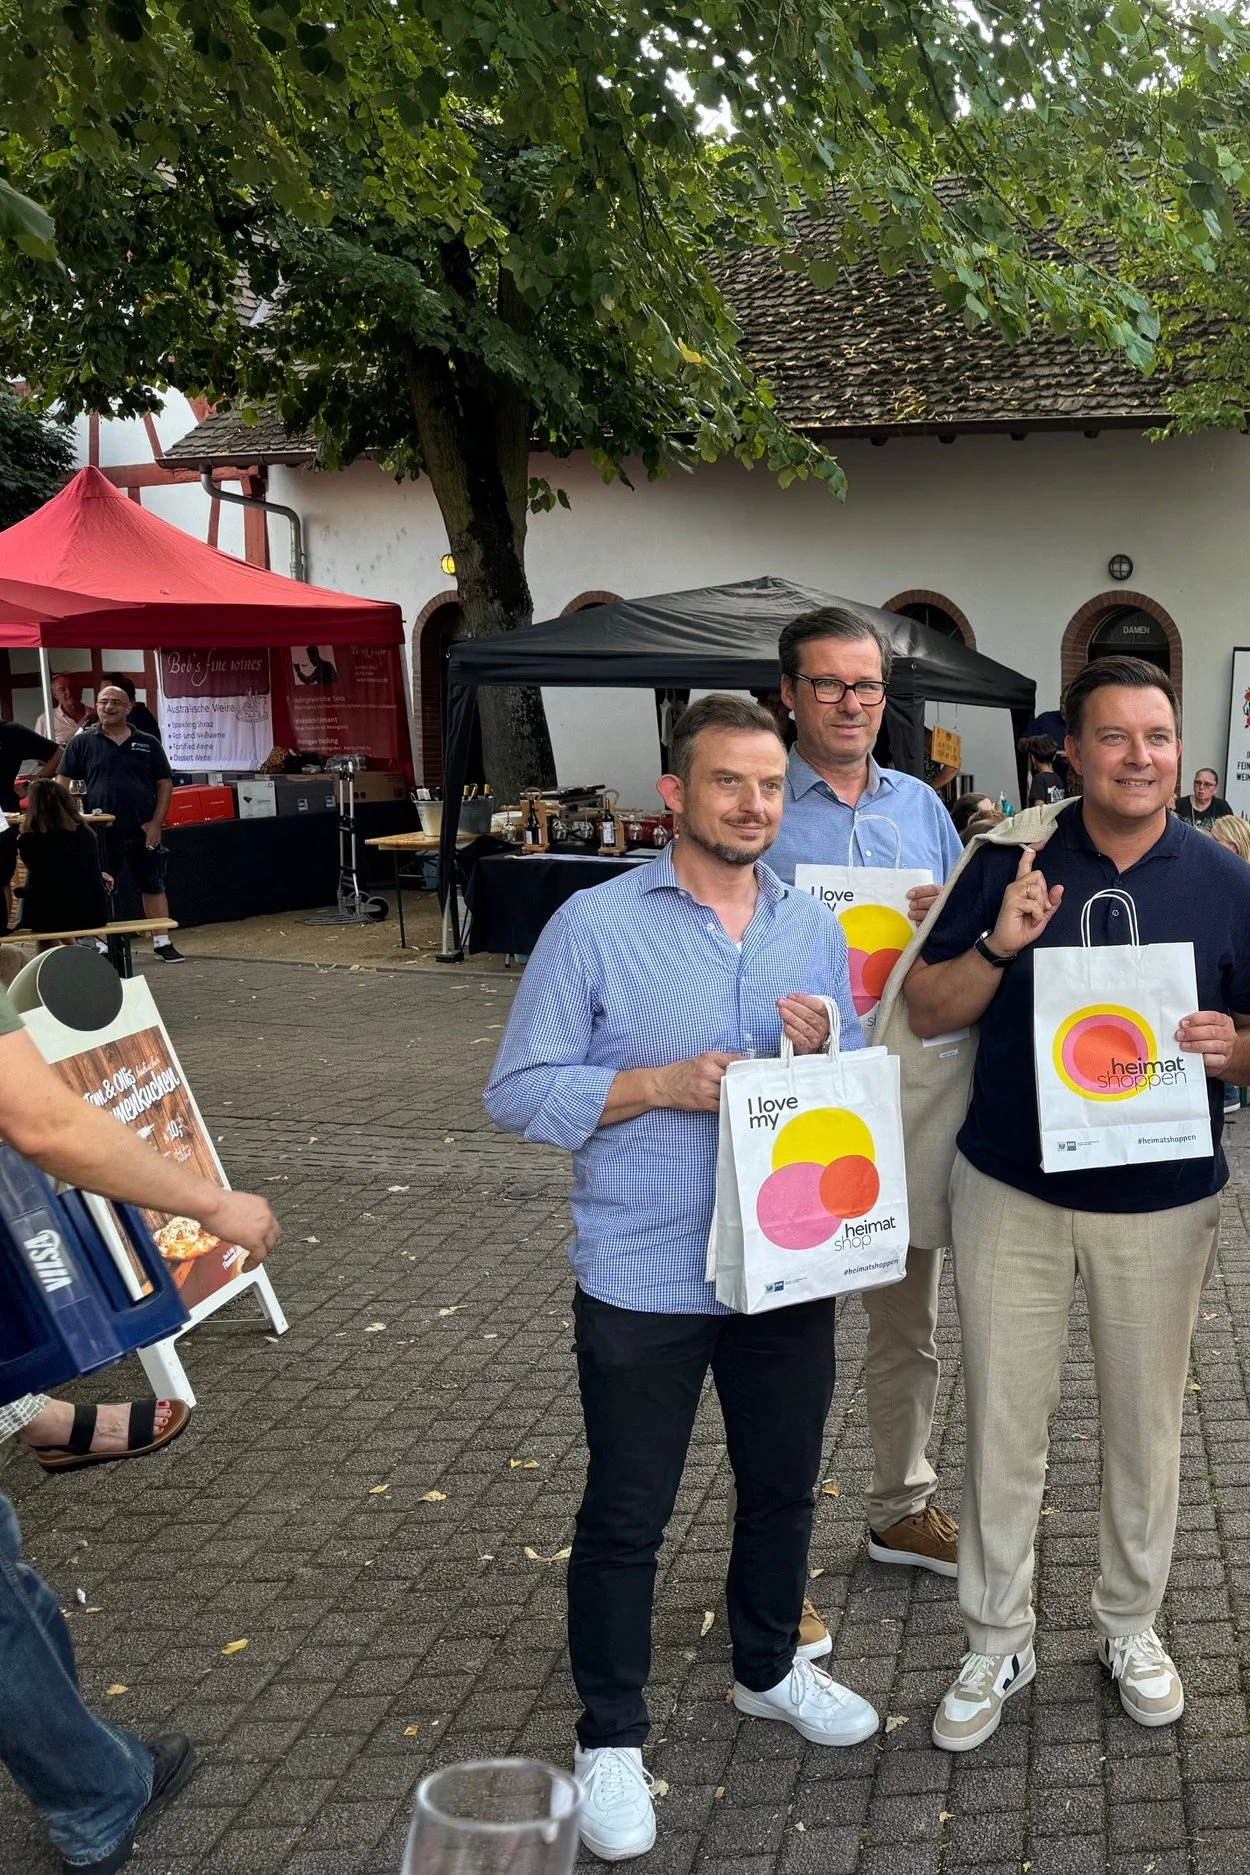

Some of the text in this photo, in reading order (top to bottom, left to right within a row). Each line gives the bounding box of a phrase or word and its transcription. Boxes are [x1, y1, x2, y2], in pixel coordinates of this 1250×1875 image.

[1123, 626, 1150, 634] DAMEN
[168, 647, 262, 687] Bob's fine wines
[167, 703, 235, 714] Australische Weine
[183, 731, 195, 739] und
[820, 886, 854, 902] love
[1111, 1056, 1186, 1075] heimat
[103, 1079, 117, 1099] &
[1097, 1071, 1187, 1091] shoppen
[747, 1096, 799, 1115] I love
[749, 1112, 780, 1131] my
[1137, 1134, 1197, 1145] #heimatshoppen
[844, 1216, 897, 1238] heimat
[833, 1233, 872, 1252] shop
[24, 1229, 72, 1293] VILSA
[843, 1258, 899, 1277] #heimatshoppen
